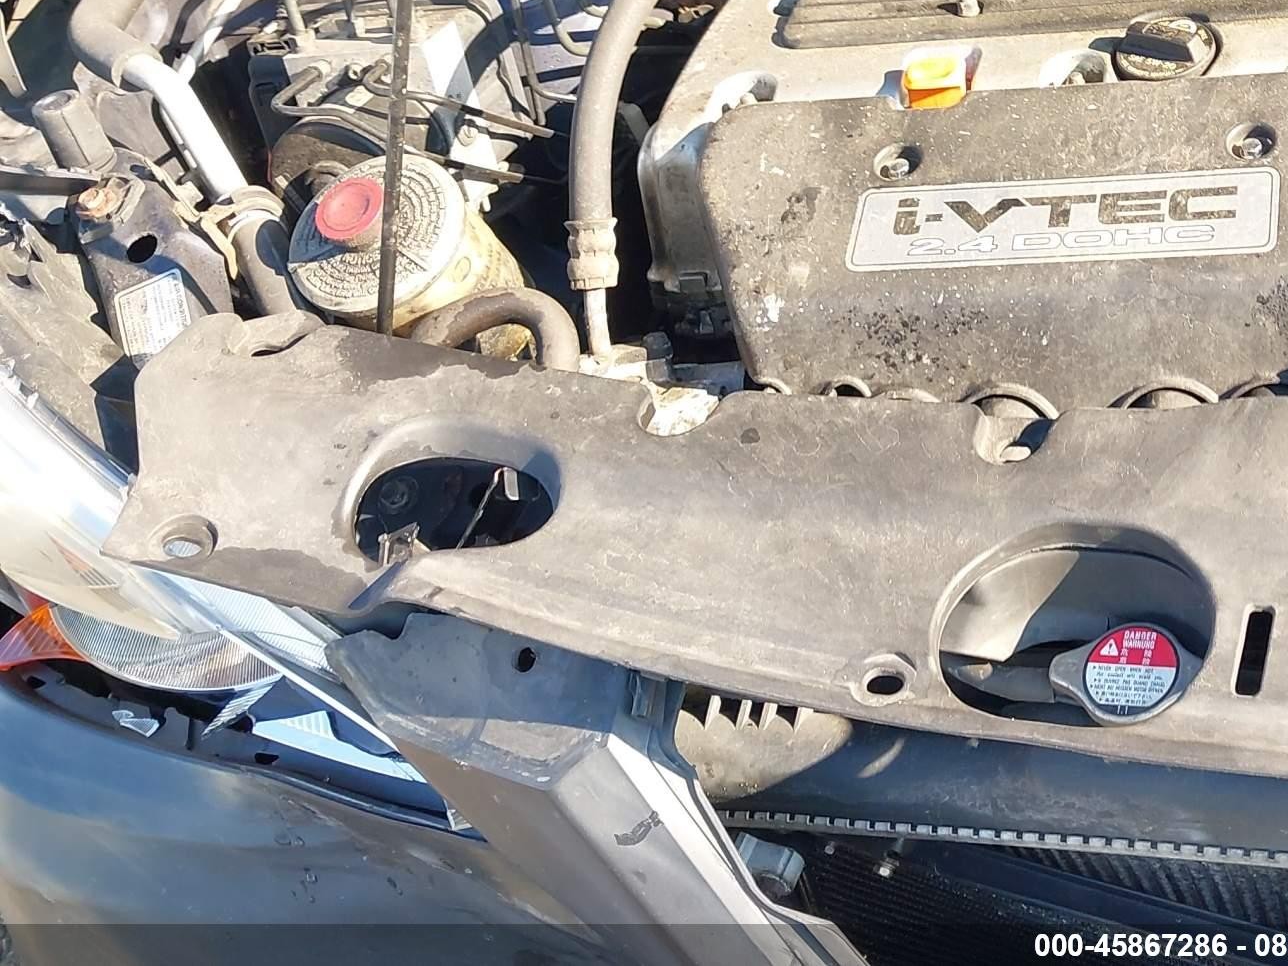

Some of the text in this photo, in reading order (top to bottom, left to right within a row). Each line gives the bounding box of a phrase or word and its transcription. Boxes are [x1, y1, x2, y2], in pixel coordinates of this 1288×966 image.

[893, 185, 1239, 235] i-VTEC
[906, 224, 1216, 257] 2.4 DOHC
[1124, 630, 1157, 640] DANGER
